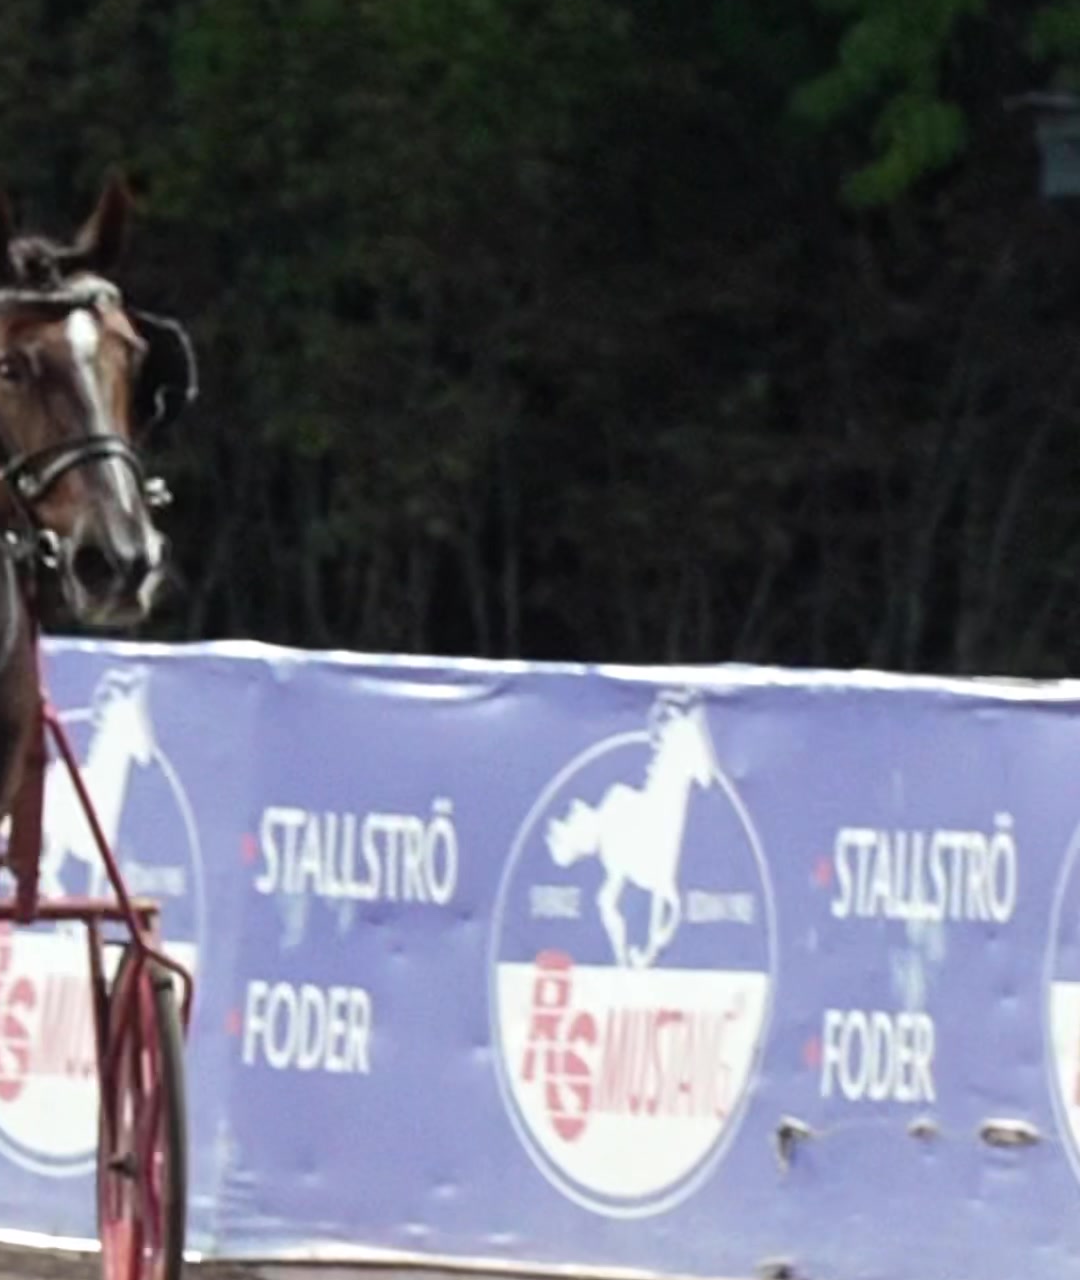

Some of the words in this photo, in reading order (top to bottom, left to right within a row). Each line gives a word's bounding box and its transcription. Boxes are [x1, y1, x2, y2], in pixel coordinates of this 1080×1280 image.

[256, 799, 457, 904] STALLSTRÖ
[831, 812, 1015, 922] STALLSTRÖ
[243, 981, 372, 1074] FODER
[821, 1010, 936, 1102] FODER
